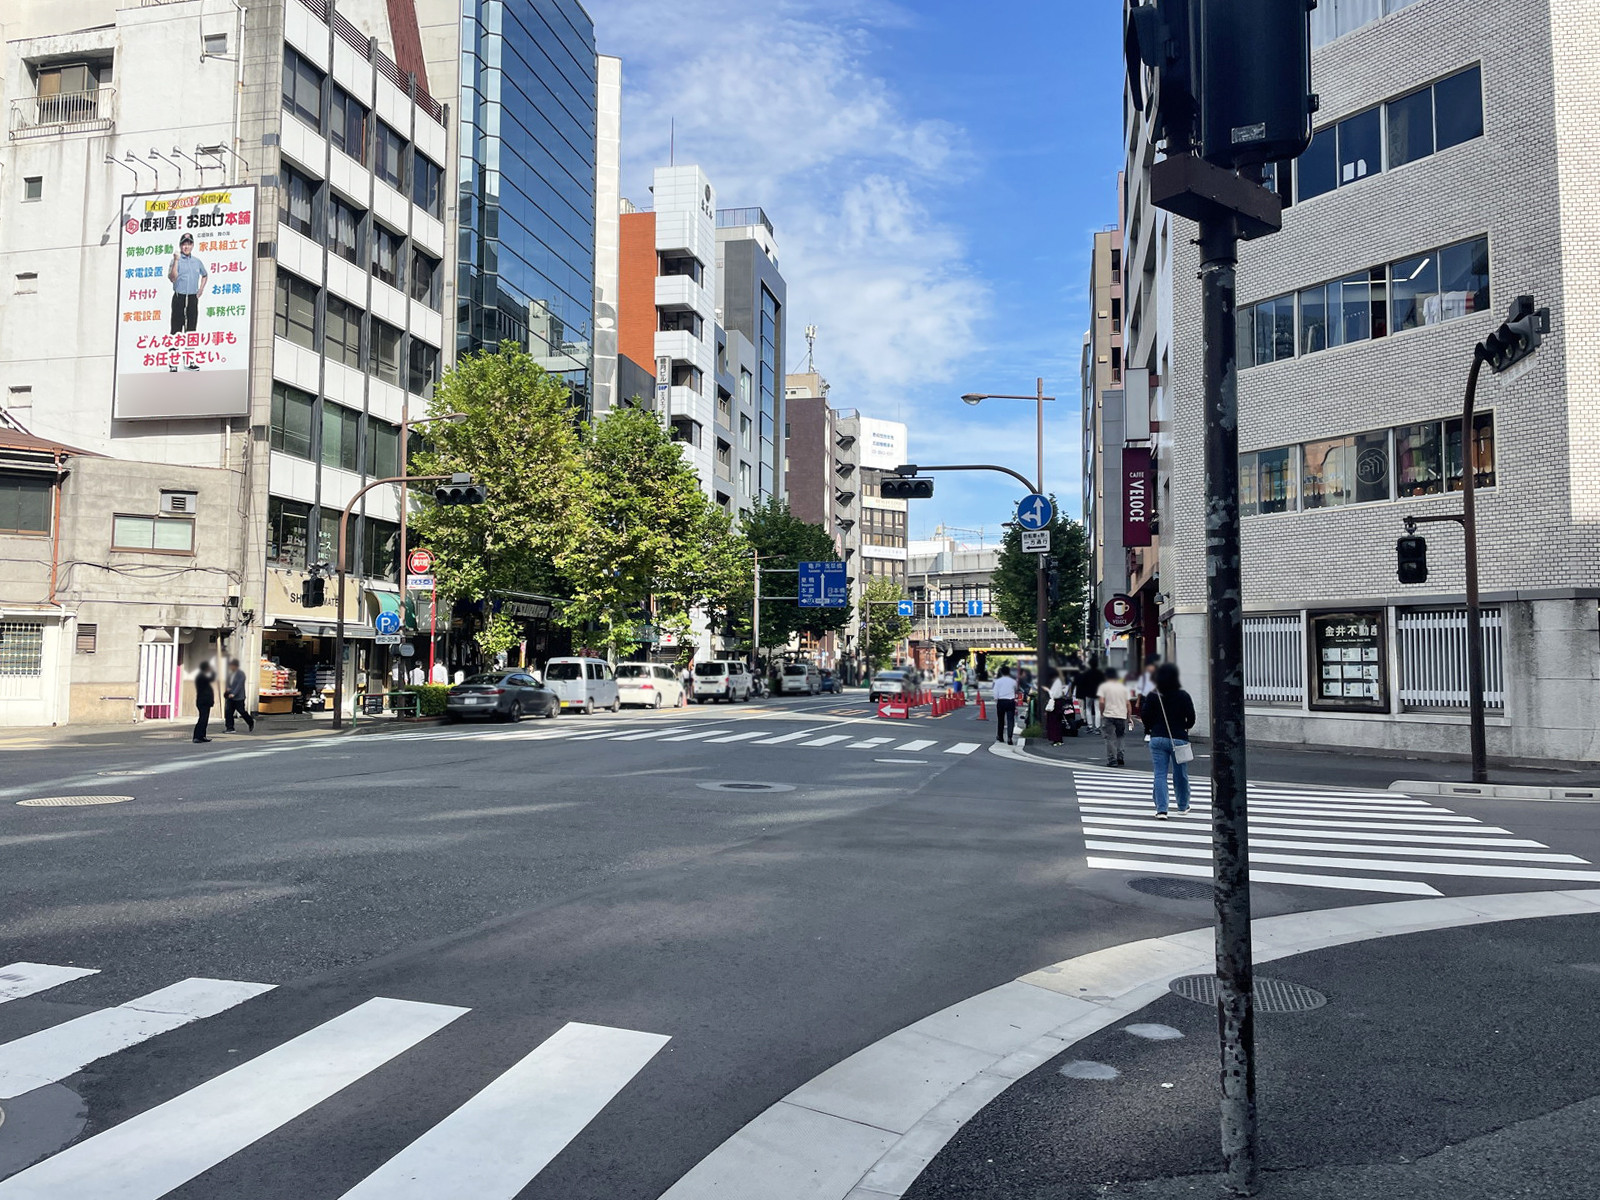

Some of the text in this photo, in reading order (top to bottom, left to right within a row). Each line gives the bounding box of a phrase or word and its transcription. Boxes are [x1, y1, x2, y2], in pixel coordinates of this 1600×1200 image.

[140, 210, 251, 232] 便利屋! お助け本舗
[126, 244, 174, 257] 荷物の移動
[199, 239, 249, 252] 家具組立て
[125, 266, 163, 279] 家電設置
[210, 261, 248, 273] 引っ越し
[128, 288, 157, 300] 片付け
[212, 283, 242, 295] お掃除
[123, 310, 162, 322] 家電設置
[206, 305, 246, 317] 事務代行
[136, 331, 237, 349] どんなお困り事も
[143, 350, 227, 367] お任せ下さい。
[1129, 479, 1145, 522] VELOCE
[381, 617, 391, 632] P
